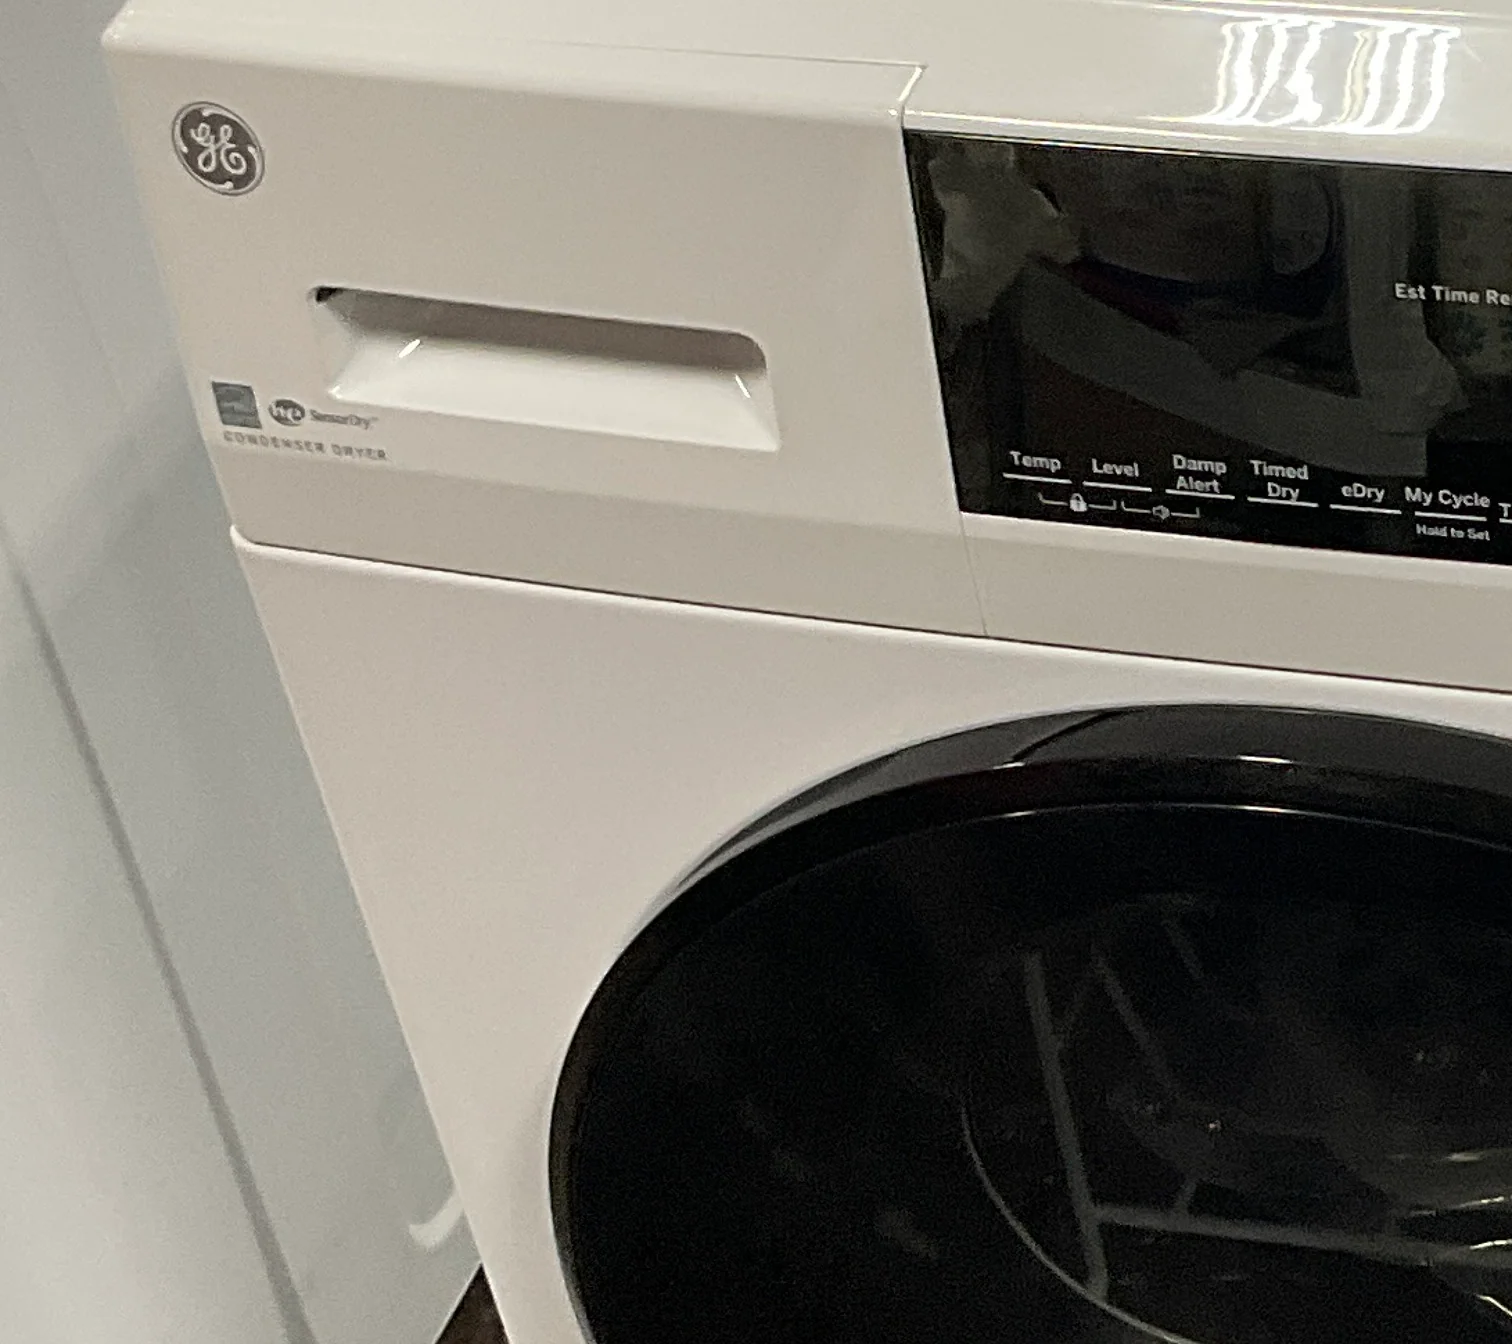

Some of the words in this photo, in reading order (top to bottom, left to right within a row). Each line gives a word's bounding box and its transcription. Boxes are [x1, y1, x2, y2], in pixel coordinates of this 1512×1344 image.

[1394, 283, 1426, 300] Est
[1432, 285, 1479, 304] Time
[1010, 451, 1062, 474] Temp
[1091, 459, 1139, 479] Level
[1172, 453, 1227, 477] Damp
[1250, 460, 1308, 480] Timed
[1176, 474, 1221, 494] Alert
[1267, 481, 1299, 503] Dry
[1341, 483, 1385, 504] eDry
[1404, 487, 1433, 509] My
[1437, 489, 1490, 512] Cycle
[1415, 523, 1446, 539] Hold
[1450, 526, 1464, 539] to
[1467, 527, 1490, 541] Set
